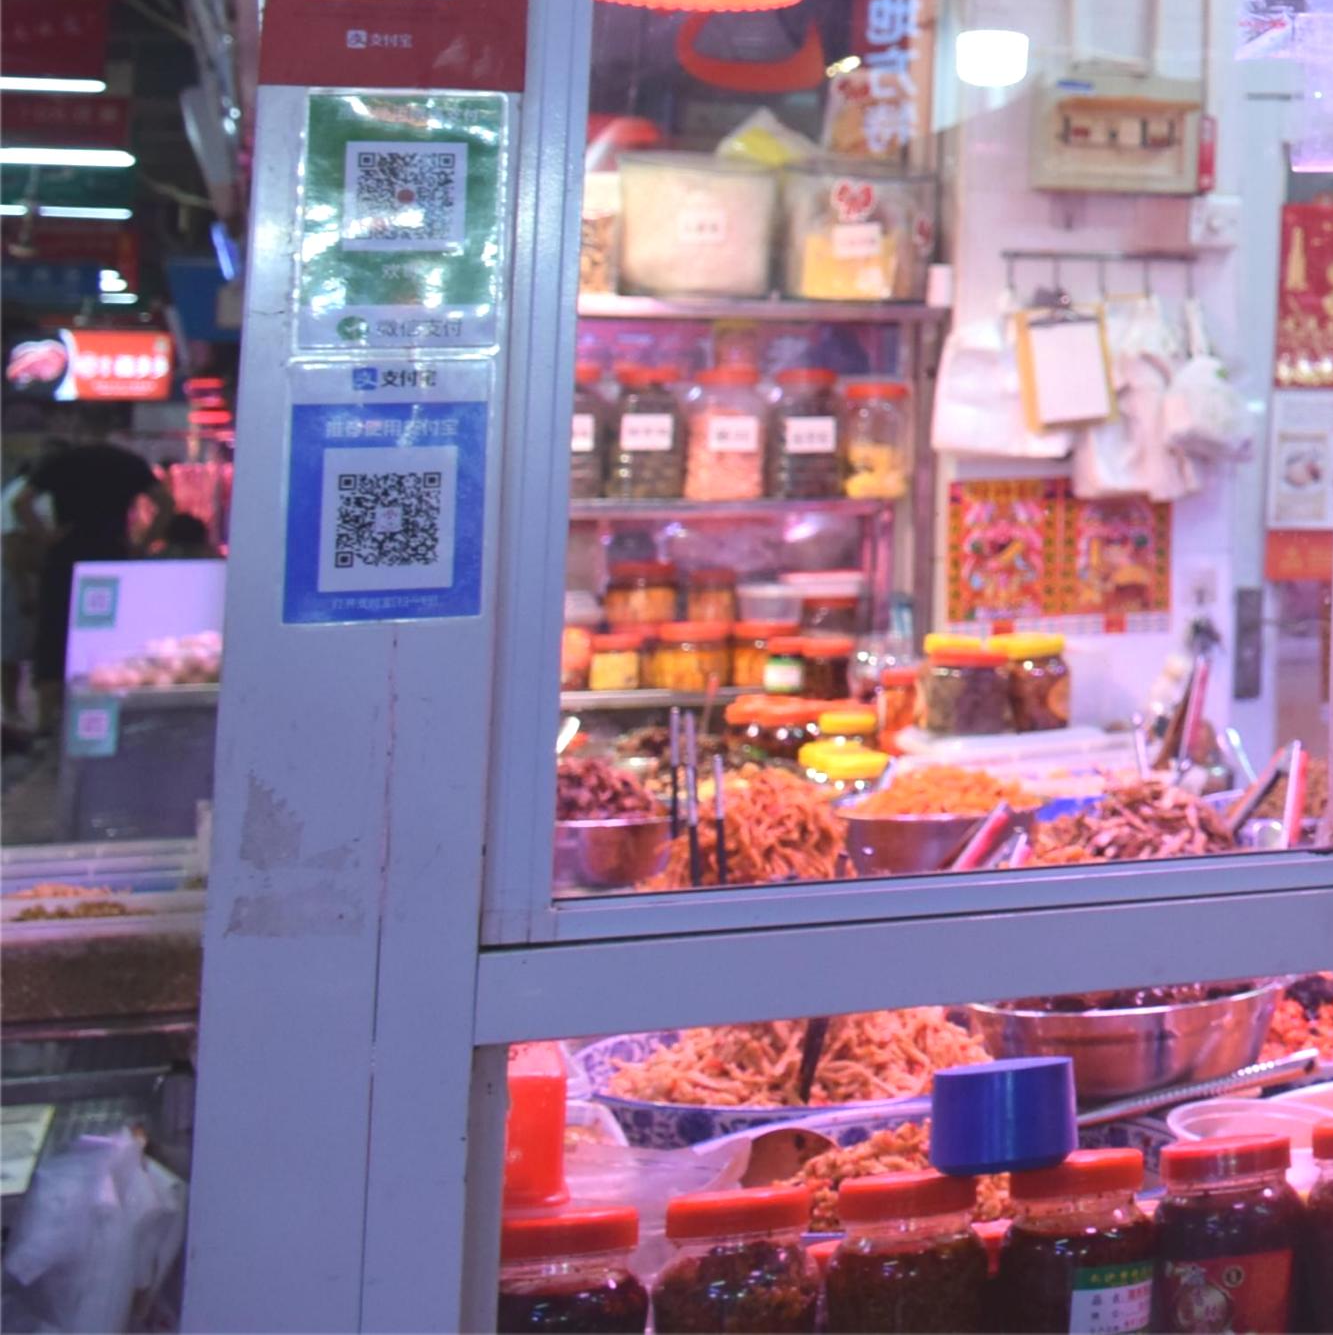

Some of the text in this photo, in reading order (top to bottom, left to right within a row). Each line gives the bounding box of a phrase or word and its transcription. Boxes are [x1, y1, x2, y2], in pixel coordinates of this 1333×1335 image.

[369, 32, 413, 49] 支付宝
[375, 318, 464, 339] 微信支付
